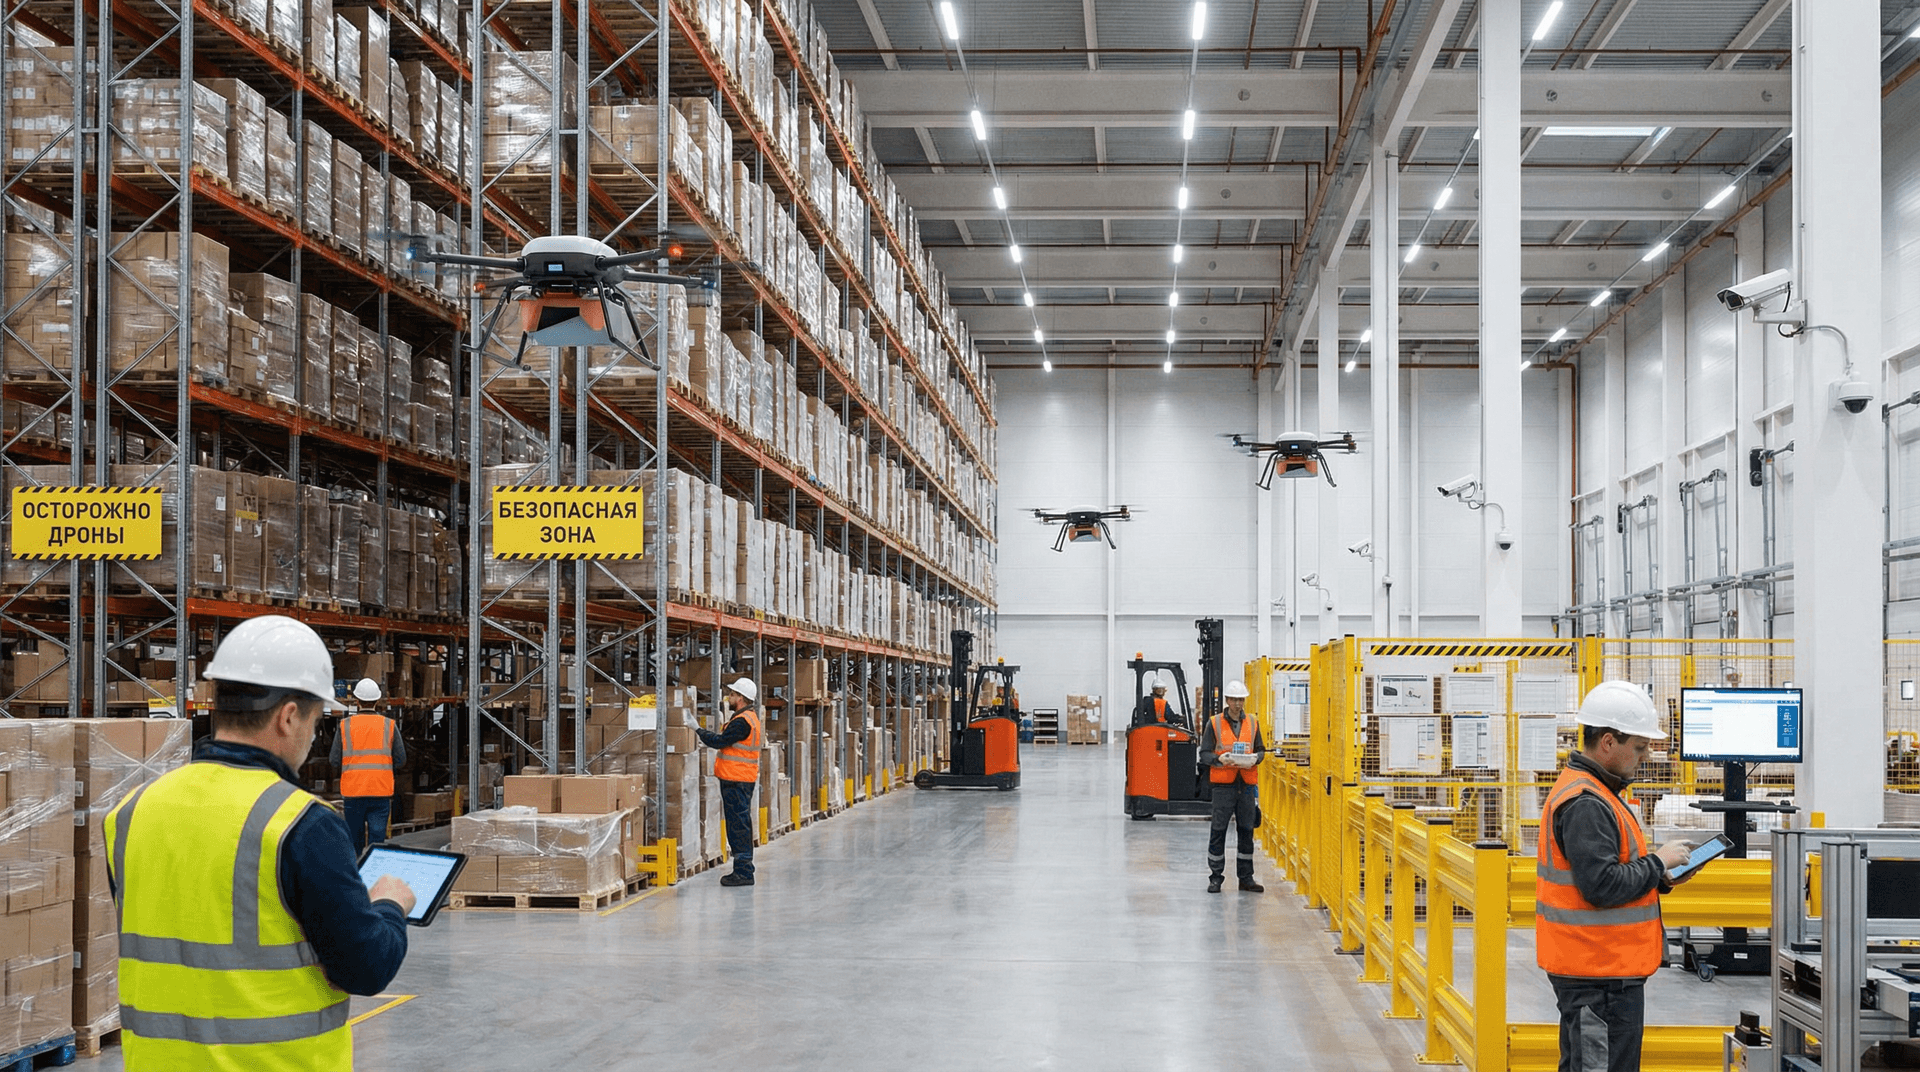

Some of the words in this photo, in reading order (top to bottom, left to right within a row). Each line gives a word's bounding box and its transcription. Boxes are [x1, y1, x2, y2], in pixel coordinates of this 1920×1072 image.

[22, 501, 151, 519] ОСТОРОЖНО
[499, 501, 637, 519] БЕЗОПАСНАЯ
[48, 526, 124, 547] ДРОНЫ
[540, 525, 596, 543] ЗОНА
